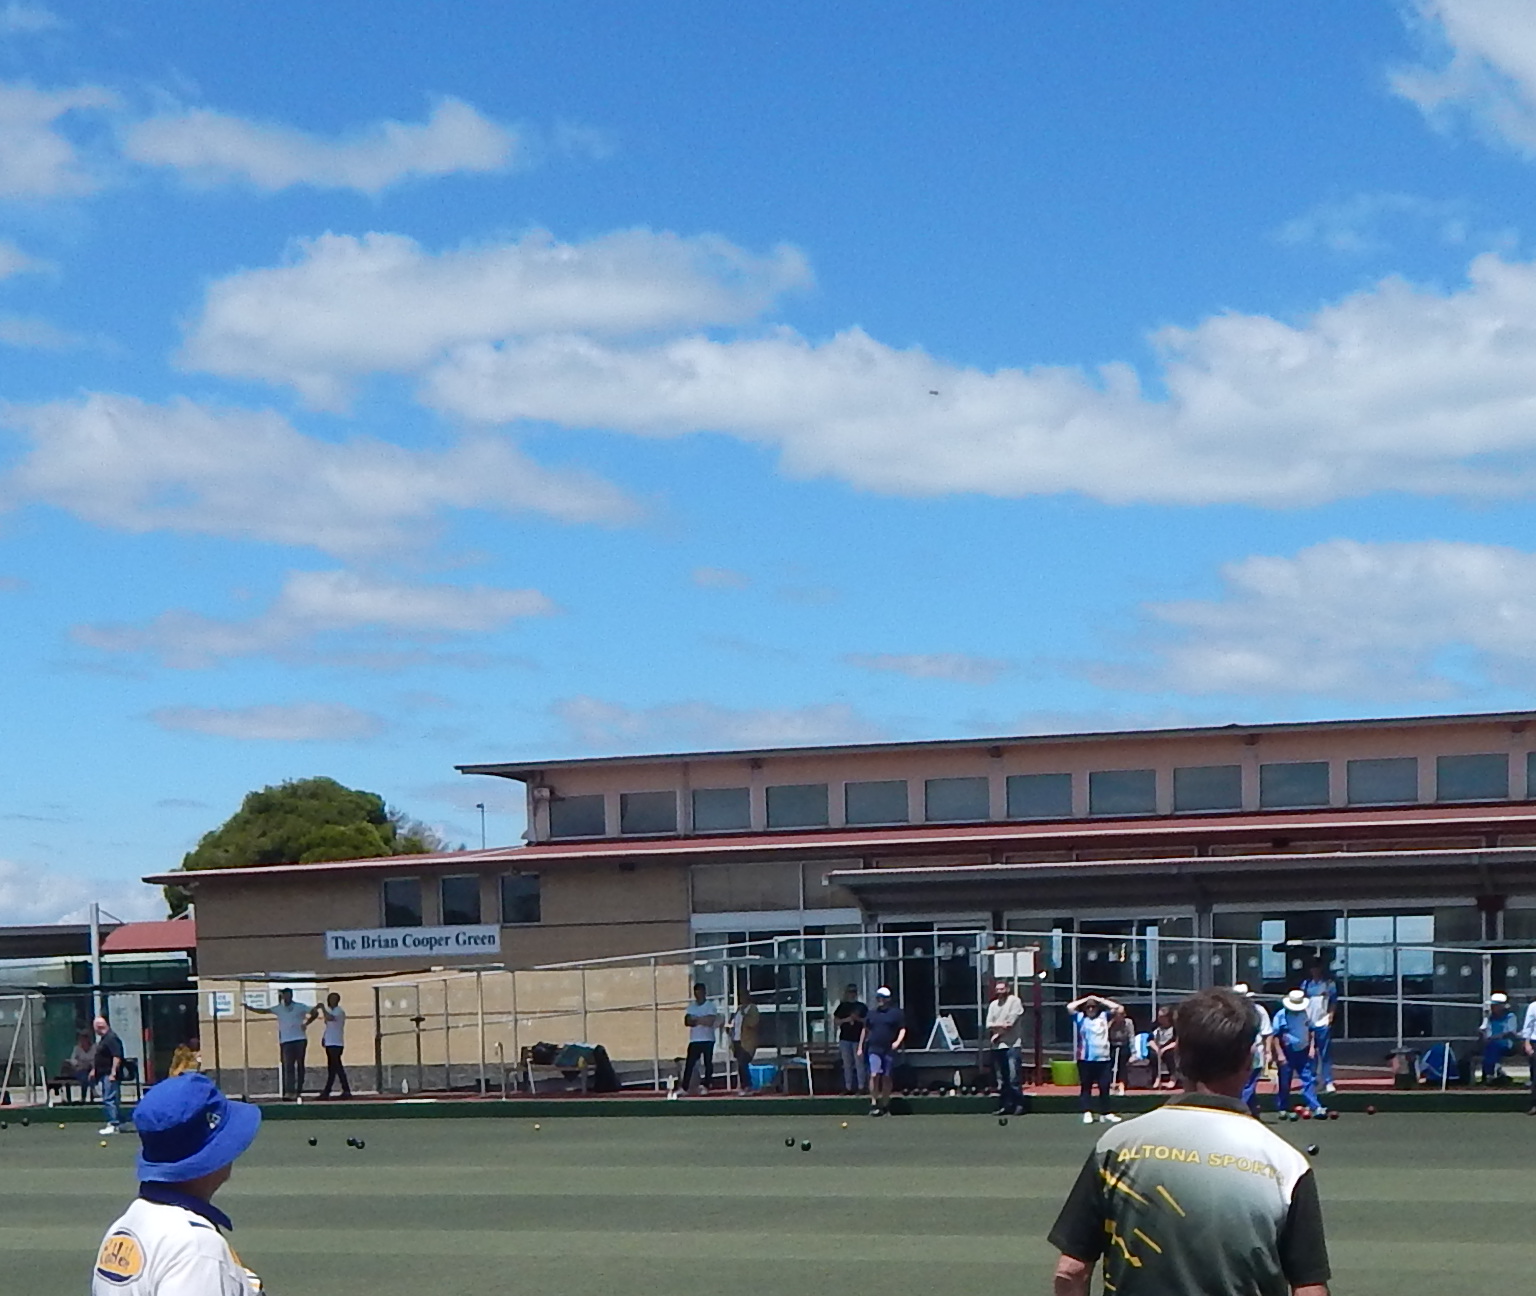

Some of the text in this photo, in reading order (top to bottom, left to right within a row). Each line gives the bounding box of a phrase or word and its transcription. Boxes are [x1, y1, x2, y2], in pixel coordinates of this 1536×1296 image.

[331, 931, 496, 950] The Brian Cooper Green
[1117, 1145, 1201, 1163] ALTONA
